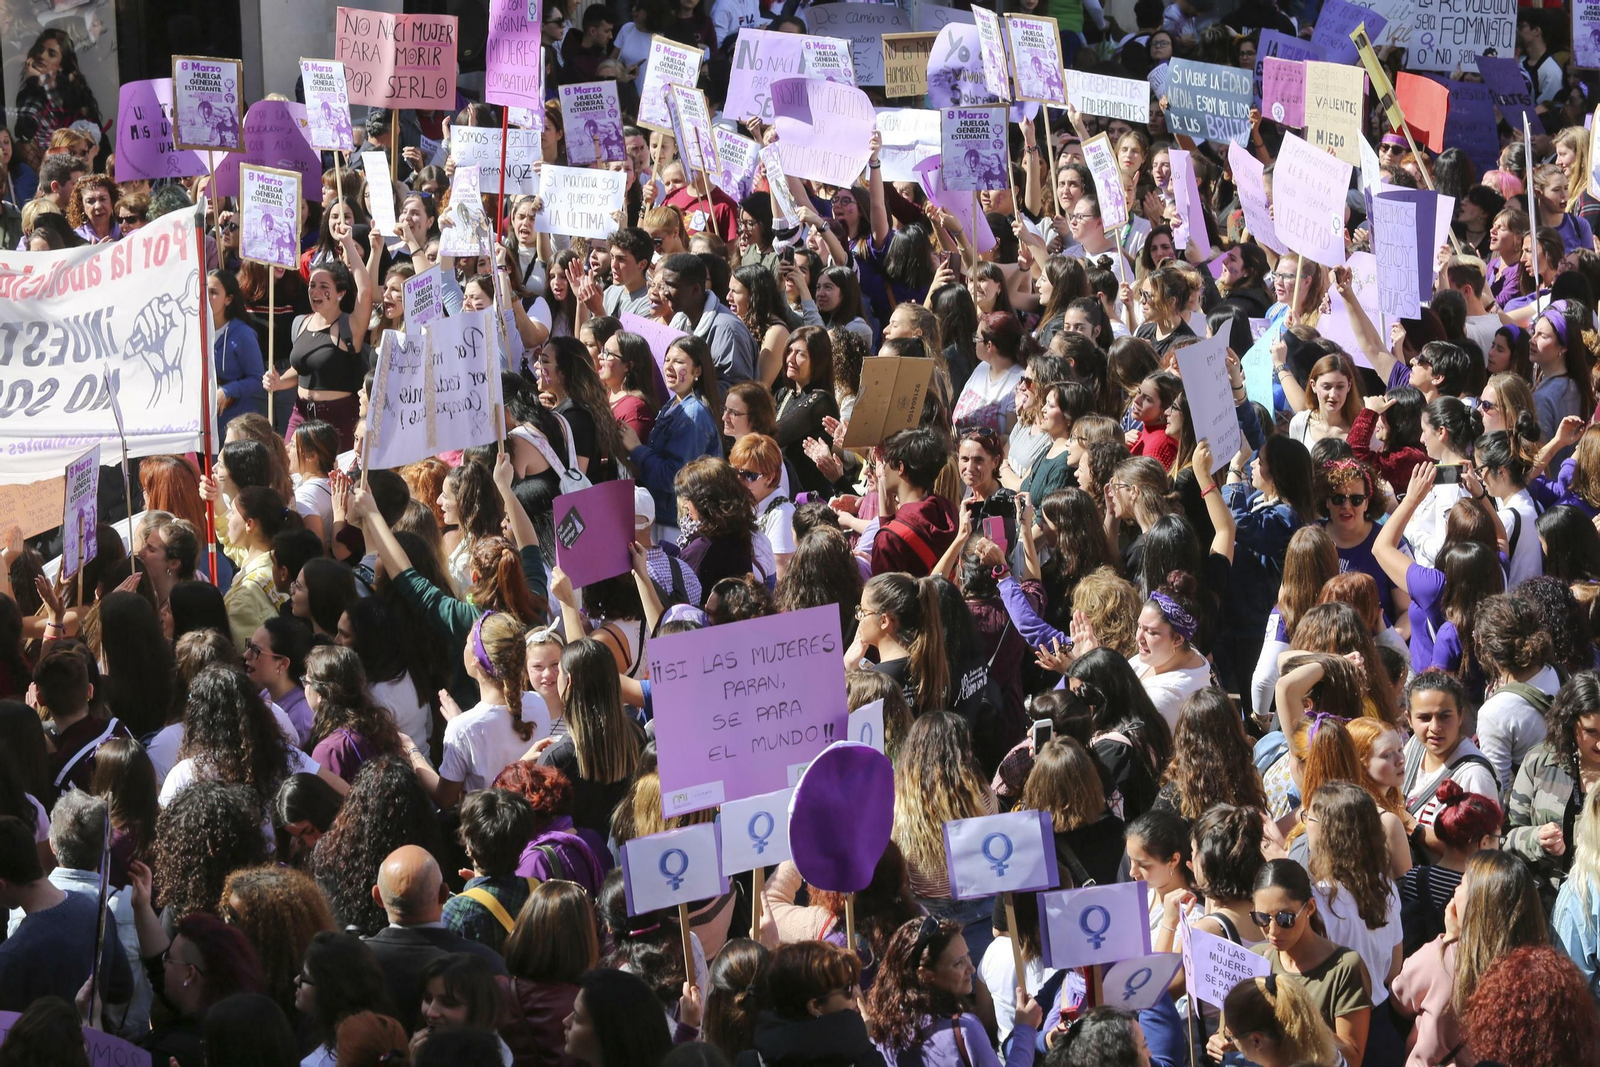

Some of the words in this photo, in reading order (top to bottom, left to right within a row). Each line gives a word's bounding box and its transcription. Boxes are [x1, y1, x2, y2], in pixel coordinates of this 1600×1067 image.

[812, 10, 838, 25] De
[846, 12, 885, 25] camino
[1013, 20, 1018, 28] 8
[1021, 20, 1043, 31] Marzo
[344, 13, 371, 36] NO
[377, 16, 409, 42] NACÍ
[412, 22, 453, 44] MUJER
[339, 37, 381, 64] PARA
[395, 47, 442, 66] MORIR
[489, 39, 537, 67] MUJERES
[656, 44, 661, 53] 8
[663, 46, 687, 60] Marzo
[805, 42, 811, 50] 8
[813, 42, 836, 50] Marzo
[885, 42, 897, 60] NO
[903, 45, 912, 60] ES
[945, 29, 971, 62] Yo
[664, 56, 686, 67] HUELGA
[1435, 48, 1452, 64] NO
[181, 62, 188, 70] 8
[191, 62, 221, 72] Marzo
[304, 62, 309, 71] 8
[311, 62, 333, 73] Marzo
[655, 67, 684, 78] ESTUDIANTIL
[659, 61, 686, 73] GENERAL
[193, 72, 222, 80] HUELGA
[345, 67, 374, 97] POR
[385, 76, 447, 99] SERLO
[1172, 65, 1182, 83] SI
[1185, 69, 1207, 87] VUELVE
[1210, 74, 1219, 90] LA
[1221, 71, 1250, 95] EDAD
[564, 87, 571, 96] 8
[574, 86, 602, 94] Marzo
[576, 93, 603, 101] HUELGA
[887, 86, 908, 96] CONTRA
[910, 85, 917, 94] EL
[570, 105, 605, 113] ESTUDIANTIL
[574, 99, 605, 107] GENERAL
[1167, 86, 1194, 110] MEDIA
[1196, 95, 1216, 114] ESTOY
[1219, 99, 1230, 117] DEL
[1232, 101, 1250, 118] LADO
[947, 111, 954, 119] 8
[958, 110, 989, 120] Marzo
[1170, 113, 1182, 129] DE
[1184, 117, 1200, 133] LAS
[814, 119, 825, 135] OR
[457, 128, 488, 145] Somos
[508, 131, 538, 145] GRITO
[717, 131, 722, 139] 8
[725, 133, 749, 149] Marzo
[1316, 129, 1345, 148] MIEDO
[720, 148, 745, 161] GENERAL
[724, 143, 746, 154] HUELGA
[249, 172, 254, 181] 8
[257, 173, 283, 186] Marzo
[546, 170, 558, 188] Si
[563, 172, 598, 190] mañana
[601, 178, 619, 194] soy
[255, 190, 283, 200] GENERAL
[259, 184, 283, 194] HUELGA
[251, 195, 283, 206] ESTUDIANTIL
[567, 190, 594, 206] quiero
[550, 210, 561, 227] LA
[1278, 202, 1331, 250] LIBERTAD
[407, 282, 412, 294] 8
[413, 275, 433, 291] Marzo
[415, 284, 433, 298] HUELGA
[414, 291, 433, 307] GENERAL
[75, 458, 93, 475] Marzo
[76, 467, 92, 481] HUELGA
[703, 651, 738, 675] LAS
[751, 633, 836, 666] MUJERES
[723, 673, 786, 701] PARAN,
[712, 712, 742, 731] SE
[756, 700, 803, 722] PARA
[708, 745, 737, 762] EL
[1217, 943, 1226, 954] SI
[1227, 947, 1246, 962] LAS
[1209, 951, 1254, 977] MUJERES
